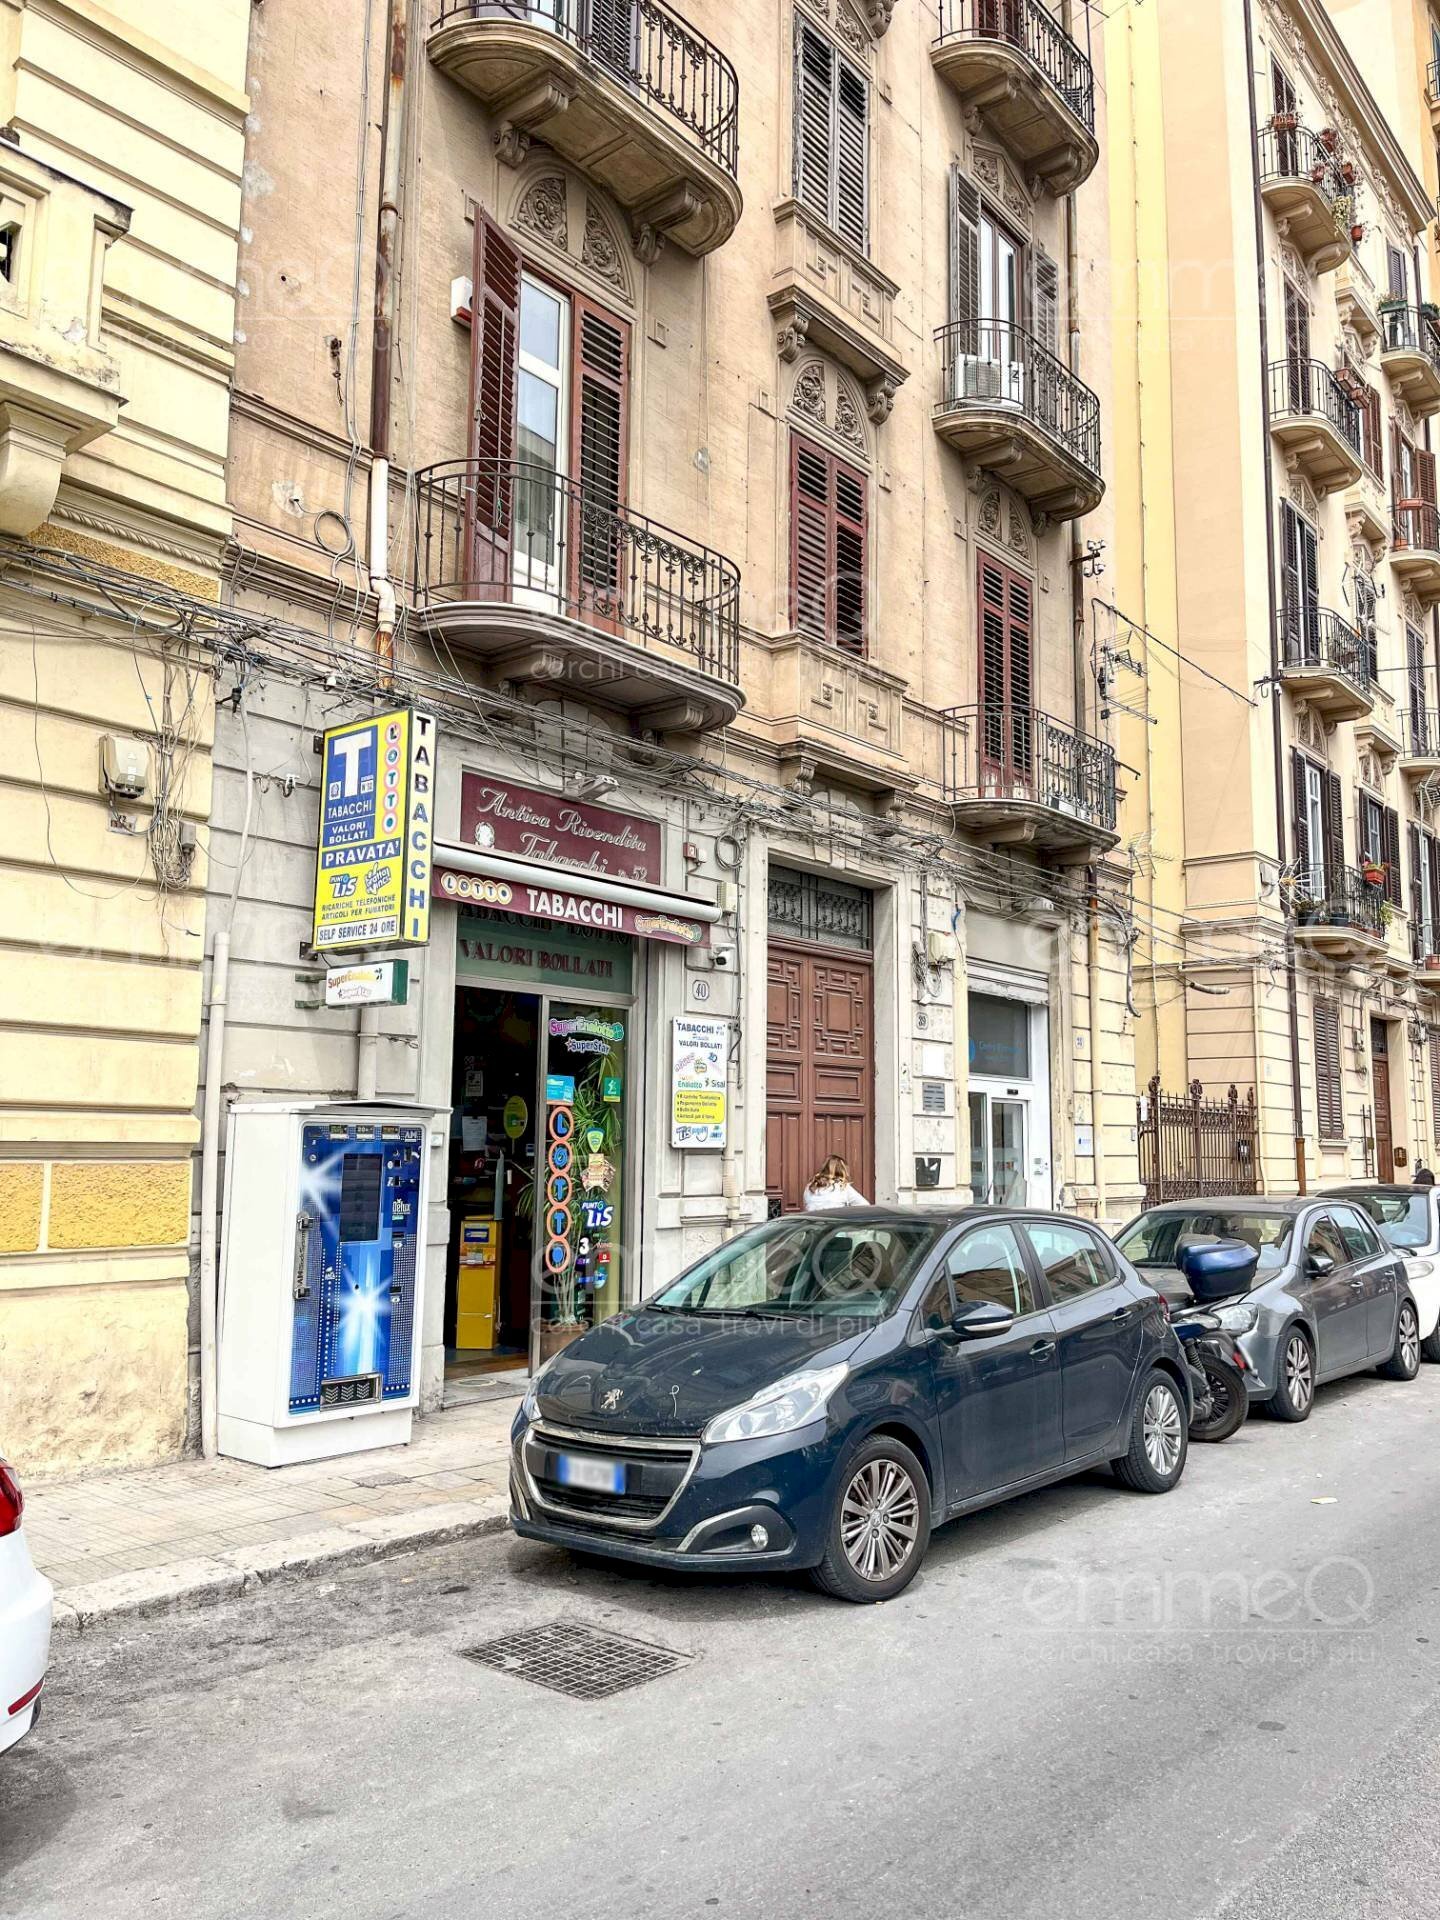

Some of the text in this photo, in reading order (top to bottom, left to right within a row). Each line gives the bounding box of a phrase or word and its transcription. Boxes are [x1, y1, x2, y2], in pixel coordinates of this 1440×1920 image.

[333, 731, 372, 797] T
[327, 799, 372, 819] TABACCHI
[332, 821, 366, 835] VALORI
[409, 715, 432, 938] TABACCHI
[477, 787, 647, 852] Antica Rivendita
[329, 830, 368, 845] BOLLATI
[325, 840, 400, 867] PRAVATA'
[321, 900, 353, 912] RICARICHE
[321, 909, 349, 921] ARTICOLI
[526, 888, 624, 929] TABACCHI
[319, 920, 396, 941] SELF SERVICE 24 ORE
[459, 939, 614, 978] VALORI BOLLATI
[695, 983, 707, 998] 40
[677, 1022, 715, 1034] TABACCHI
[679, 1040, 723, 1050] VALORI BOLLATI
[547, 1109, 574, 1271] LOTTO
